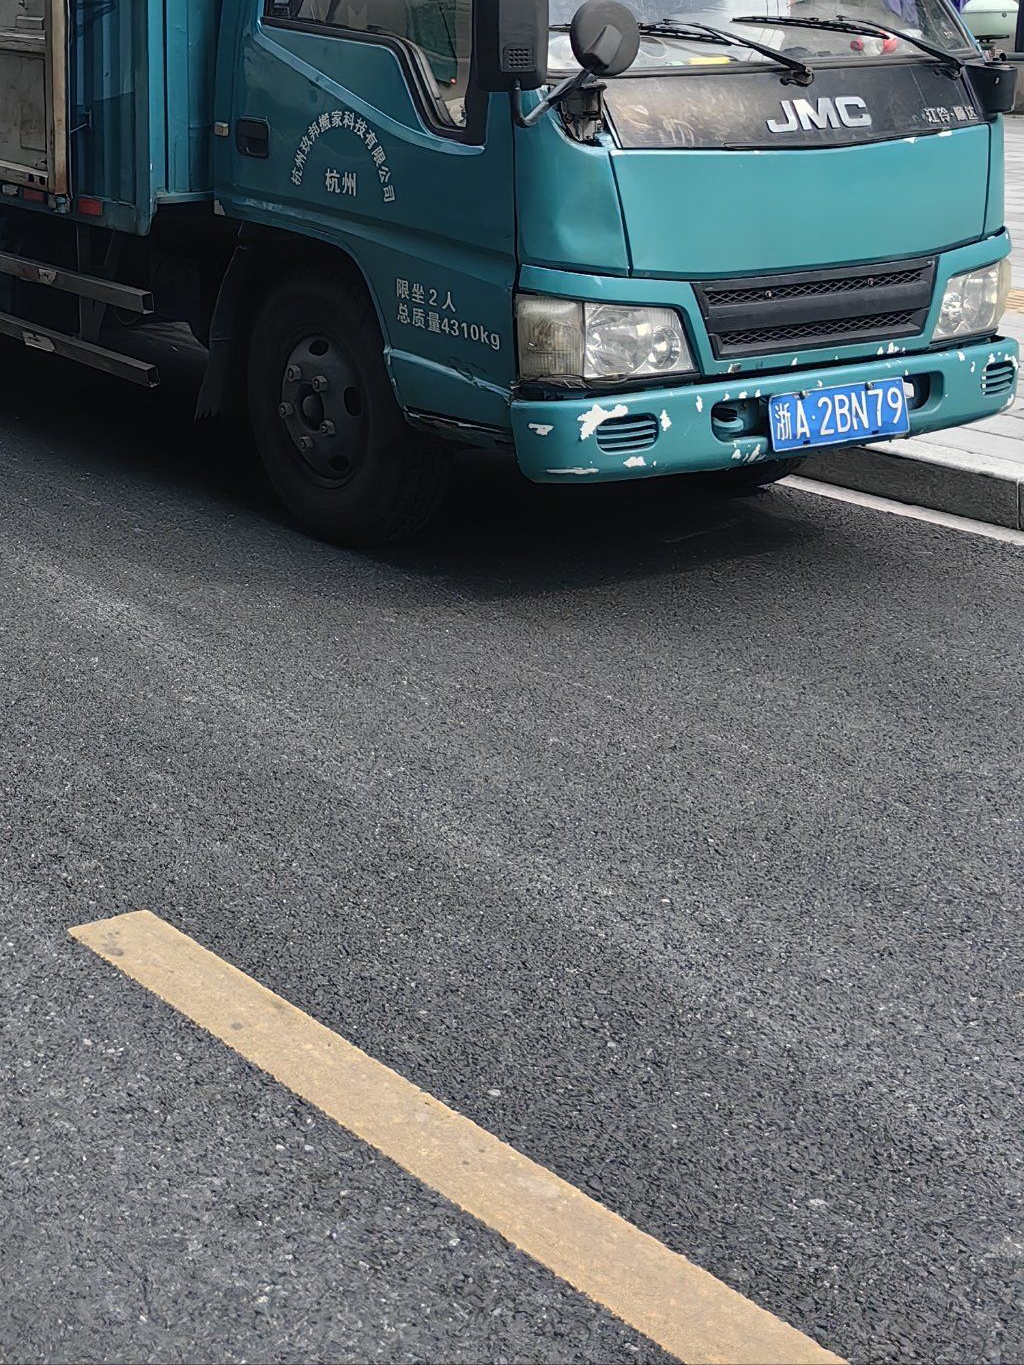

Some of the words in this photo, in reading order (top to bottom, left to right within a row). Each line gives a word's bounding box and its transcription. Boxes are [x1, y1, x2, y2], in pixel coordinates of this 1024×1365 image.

[765, 96, 872, 133] JMC
[290, 110, 396, 202] 杭州玖邦搬家科技有限公司
[325, 168, 357, 197] 杭州
[397, 302, 500, 350] 总质量4310kg
[774, 386, 903, 441] 浙A·2BN79
